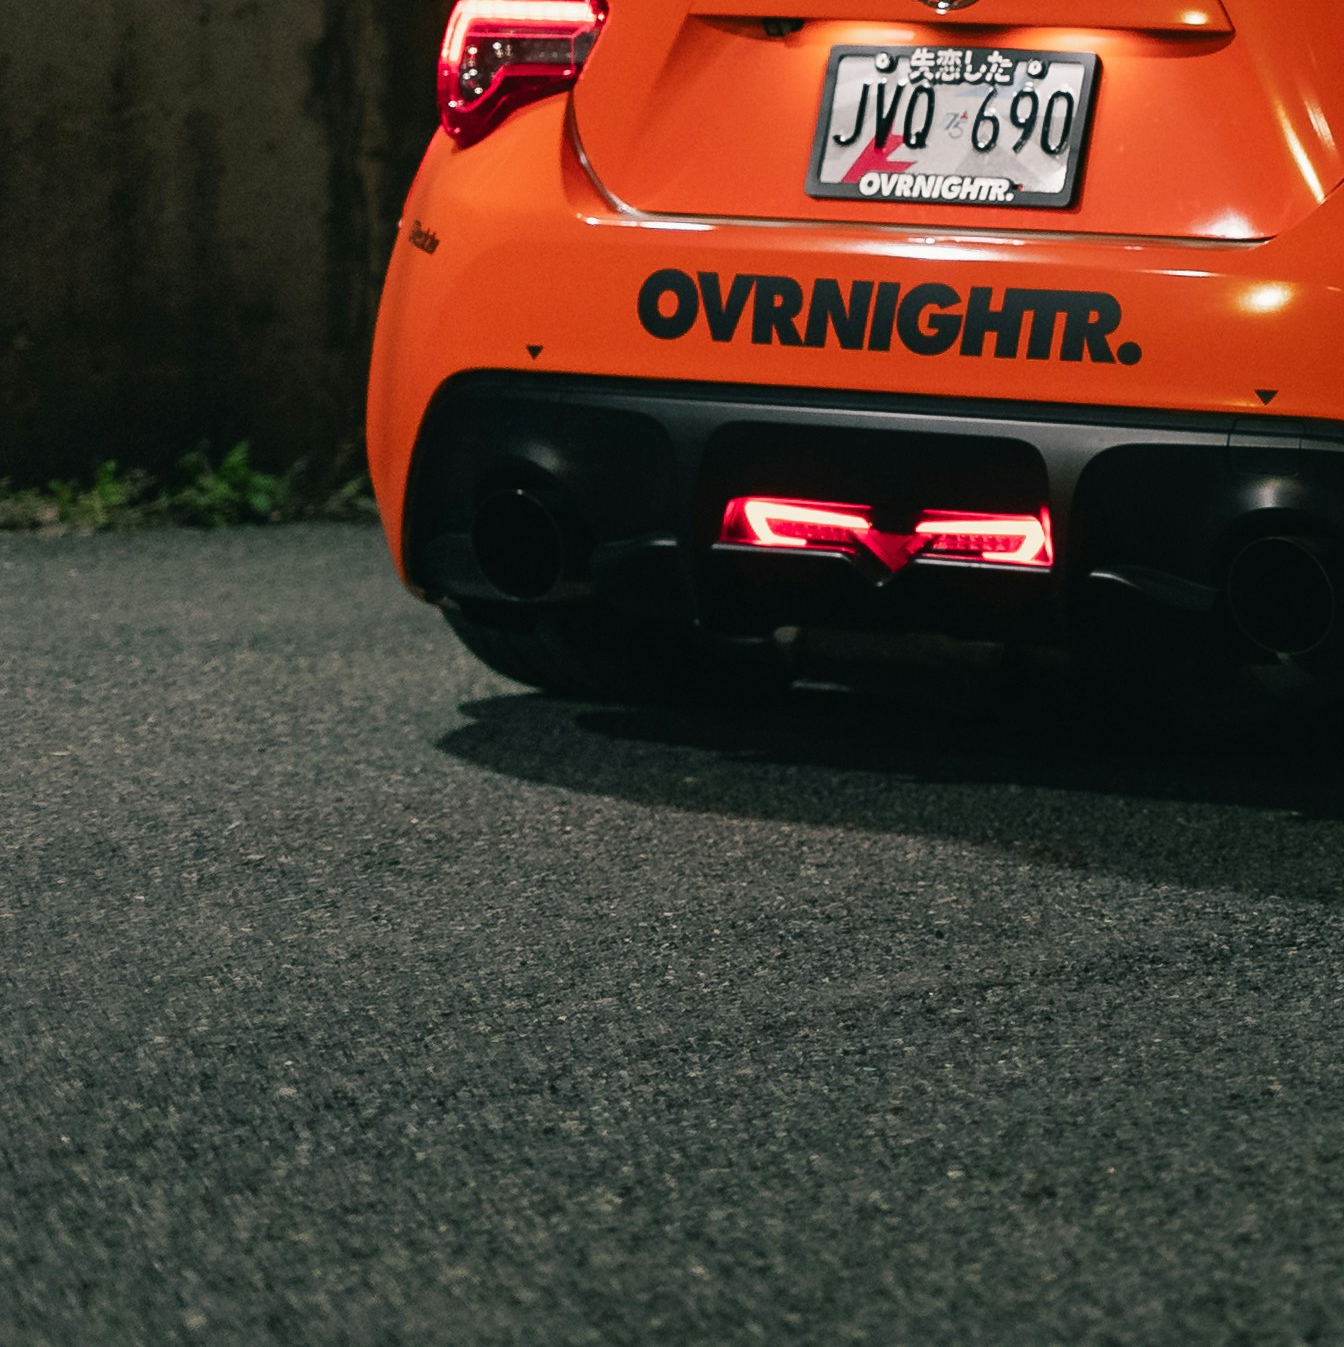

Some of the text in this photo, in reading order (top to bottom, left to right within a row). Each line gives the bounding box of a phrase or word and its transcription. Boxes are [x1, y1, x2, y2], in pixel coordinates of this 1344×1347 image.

[909, 47, 1014, 84] 失恋した
[833, 75, 1074, 156] JVQ 690
[858, 172, 1015, 201] OVRNIGHTR.
[637, 268, 1142, 365] OVRNIGHTR.
